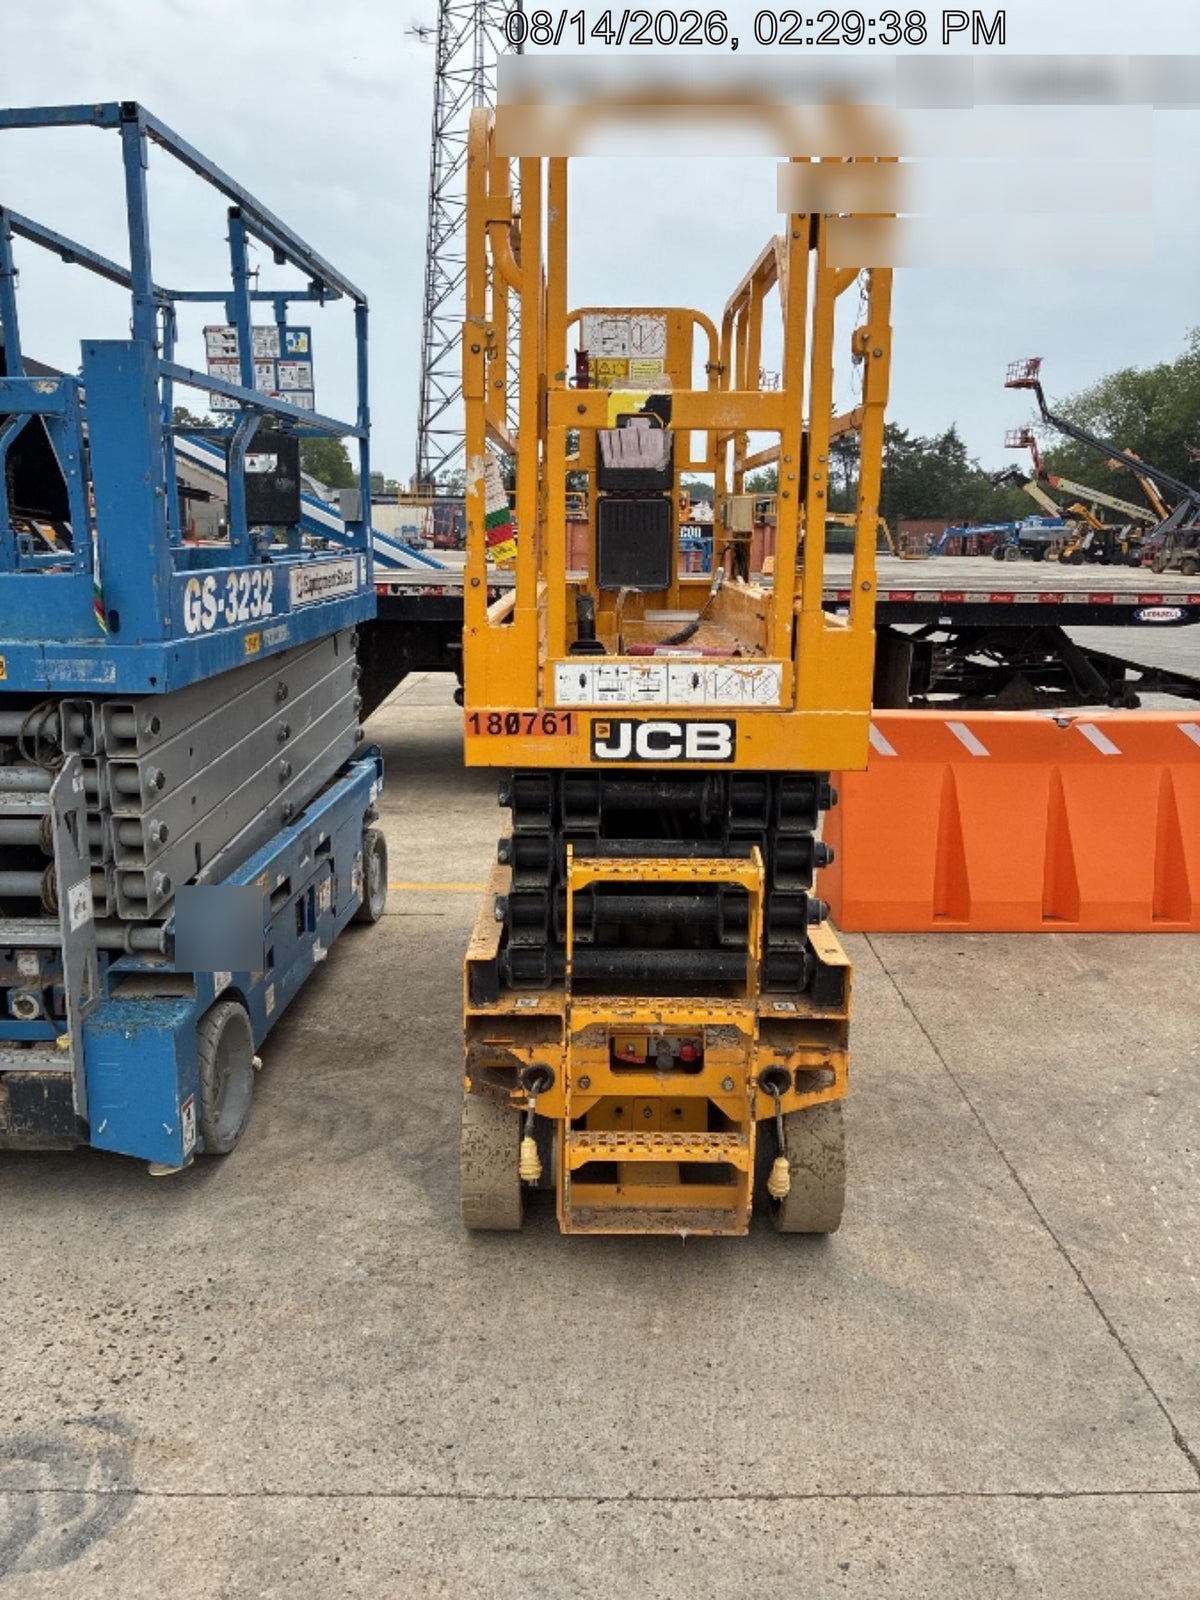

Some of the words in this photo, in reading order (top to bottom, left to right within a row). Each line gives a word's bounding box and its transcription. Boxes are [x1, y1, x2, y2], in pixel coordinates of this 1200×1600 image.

[184, 568, 274, 634] GS-3232
[468, 712, 574, 736] 180761
[595, 722, 733, 759] JCB
